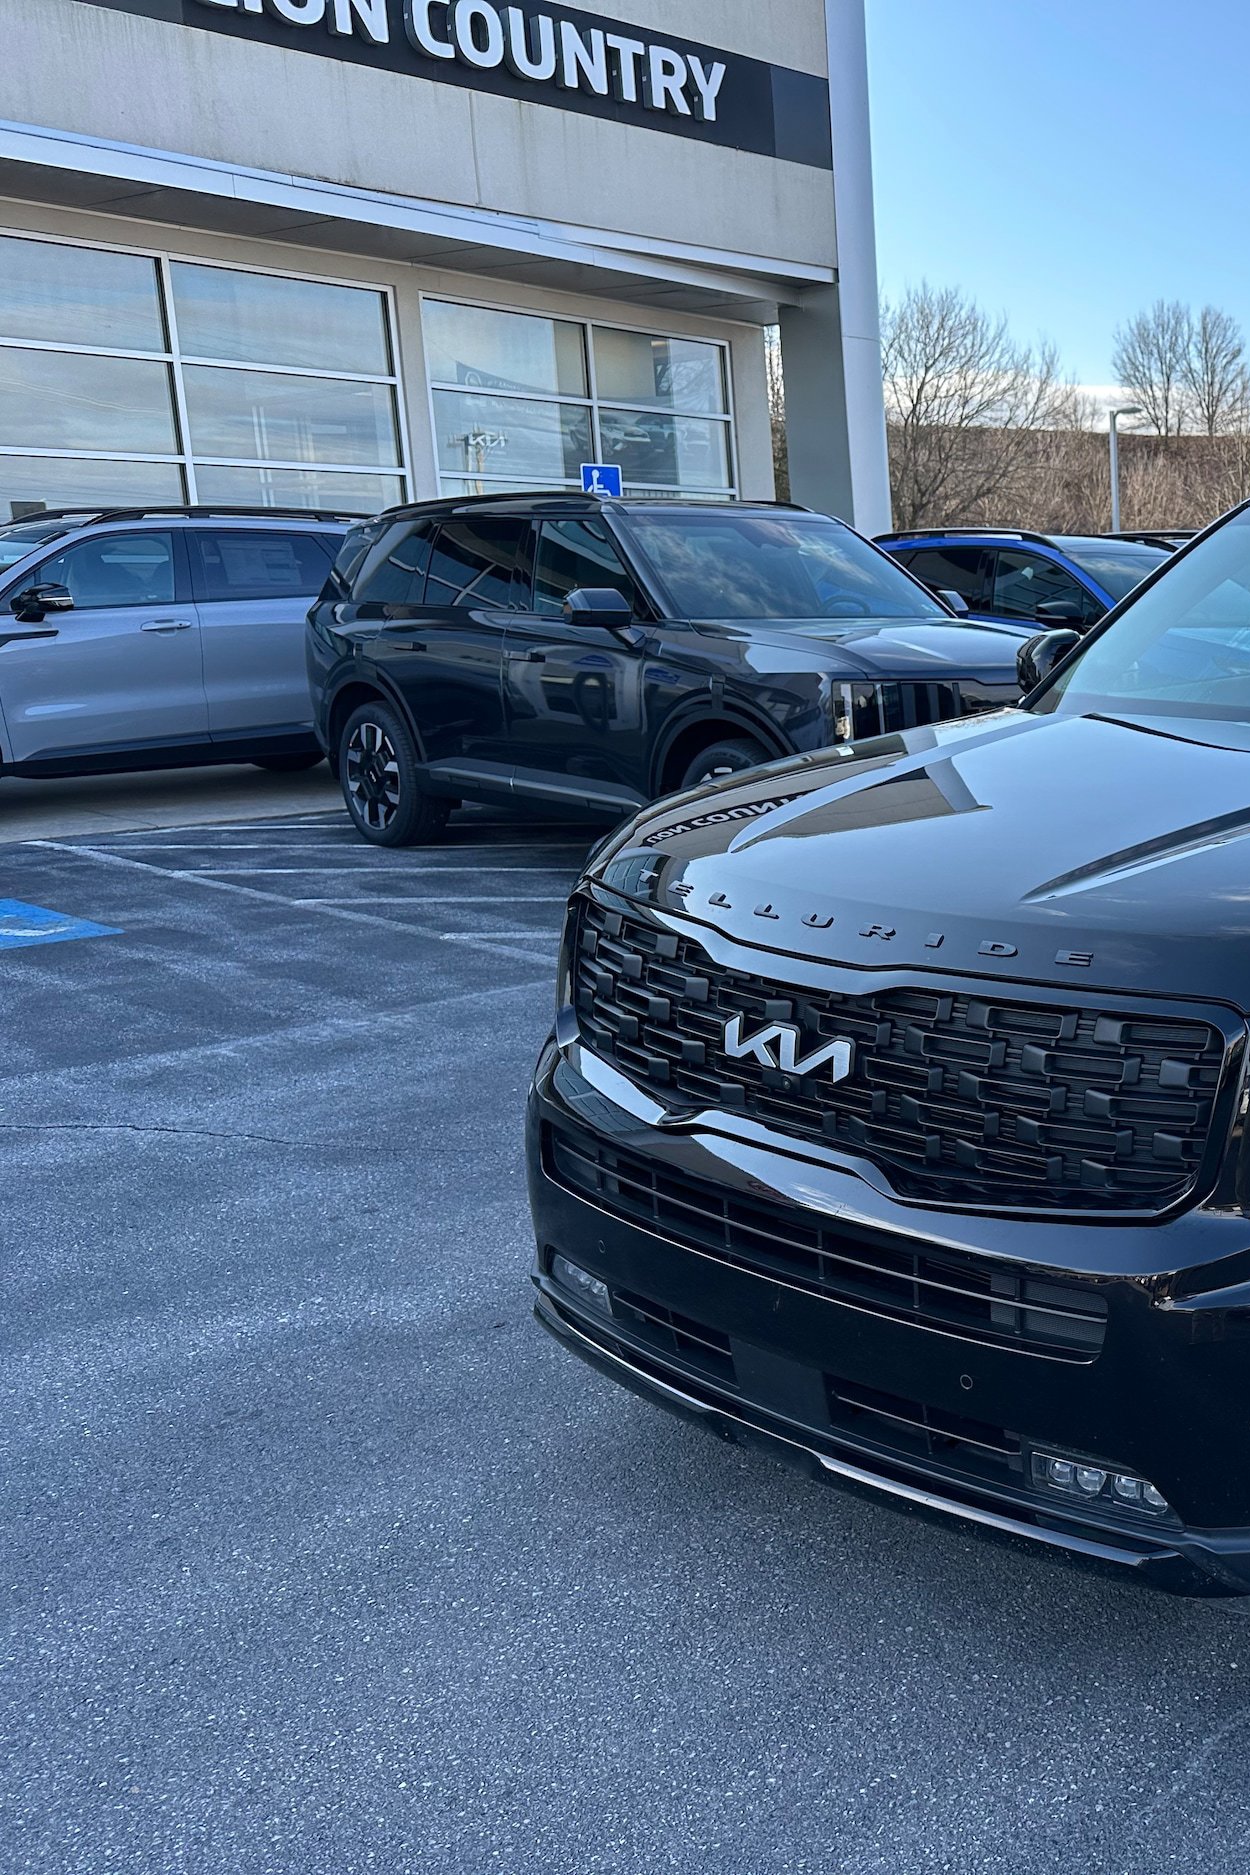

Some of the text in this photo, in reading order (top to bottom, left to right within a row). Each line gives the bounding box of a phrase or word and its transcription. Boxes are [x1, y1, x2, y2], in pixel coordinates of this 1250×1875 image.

[410, 0, 727, 122] COUNTRY
[638, 867, 1095, 967] TELLURIDE
[724, 1015, 851, 1084] KIA
